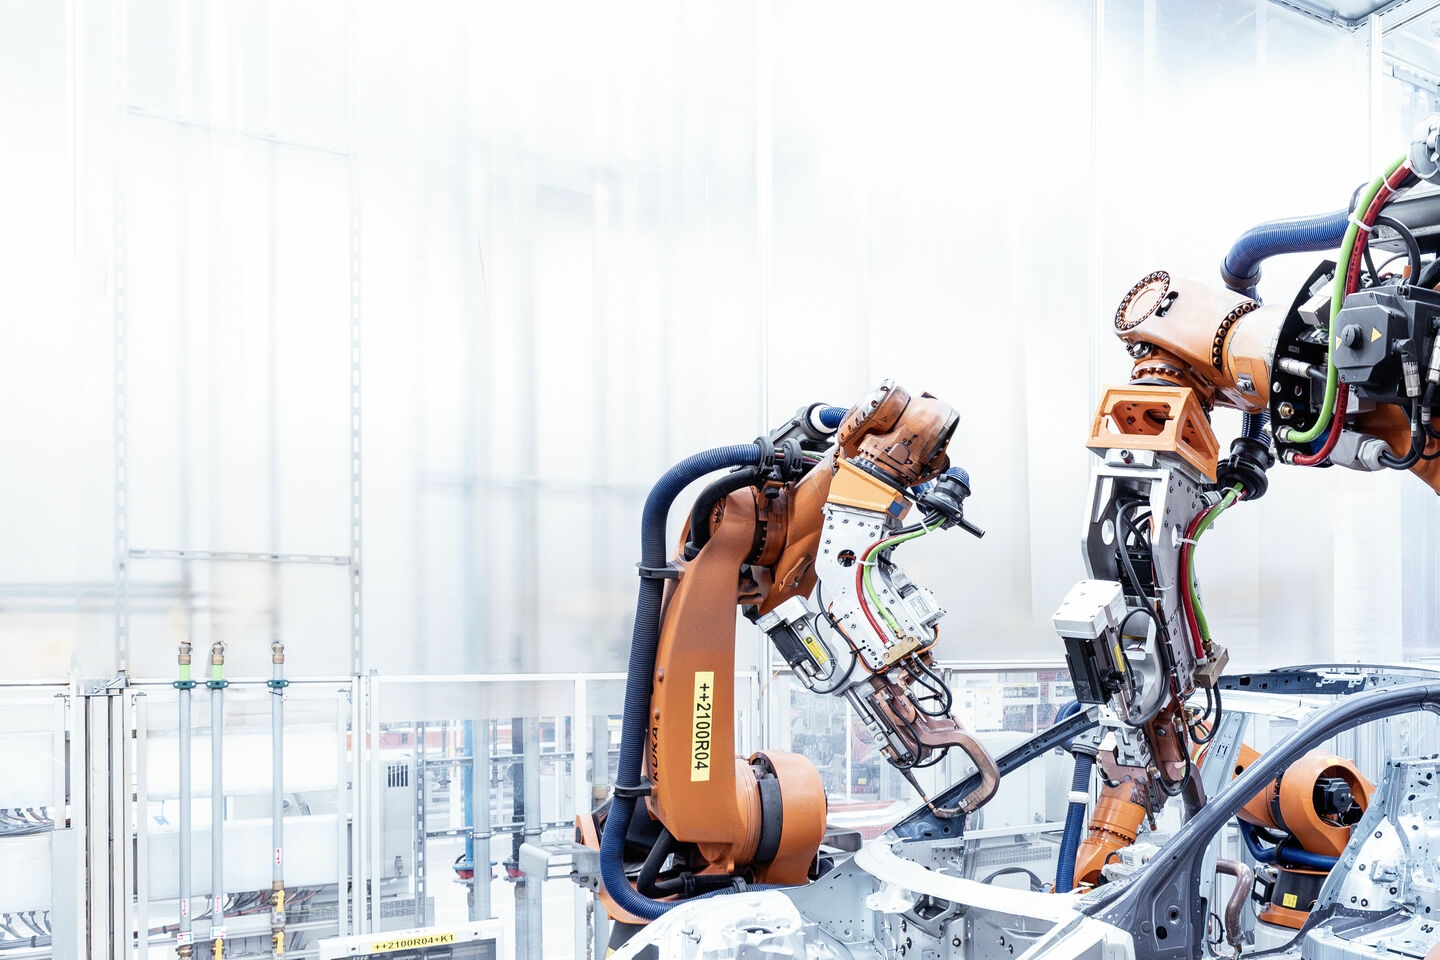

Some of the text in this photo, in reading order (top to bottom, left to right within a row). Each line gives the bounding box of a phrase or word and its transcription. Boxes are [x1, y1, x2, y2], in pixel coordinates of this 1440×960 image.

[694, 683, 712, 770] ++2100R04
[651, 727, 659, 782] KUKA
[375, 934, 454, 950] ++2100R04+K1
